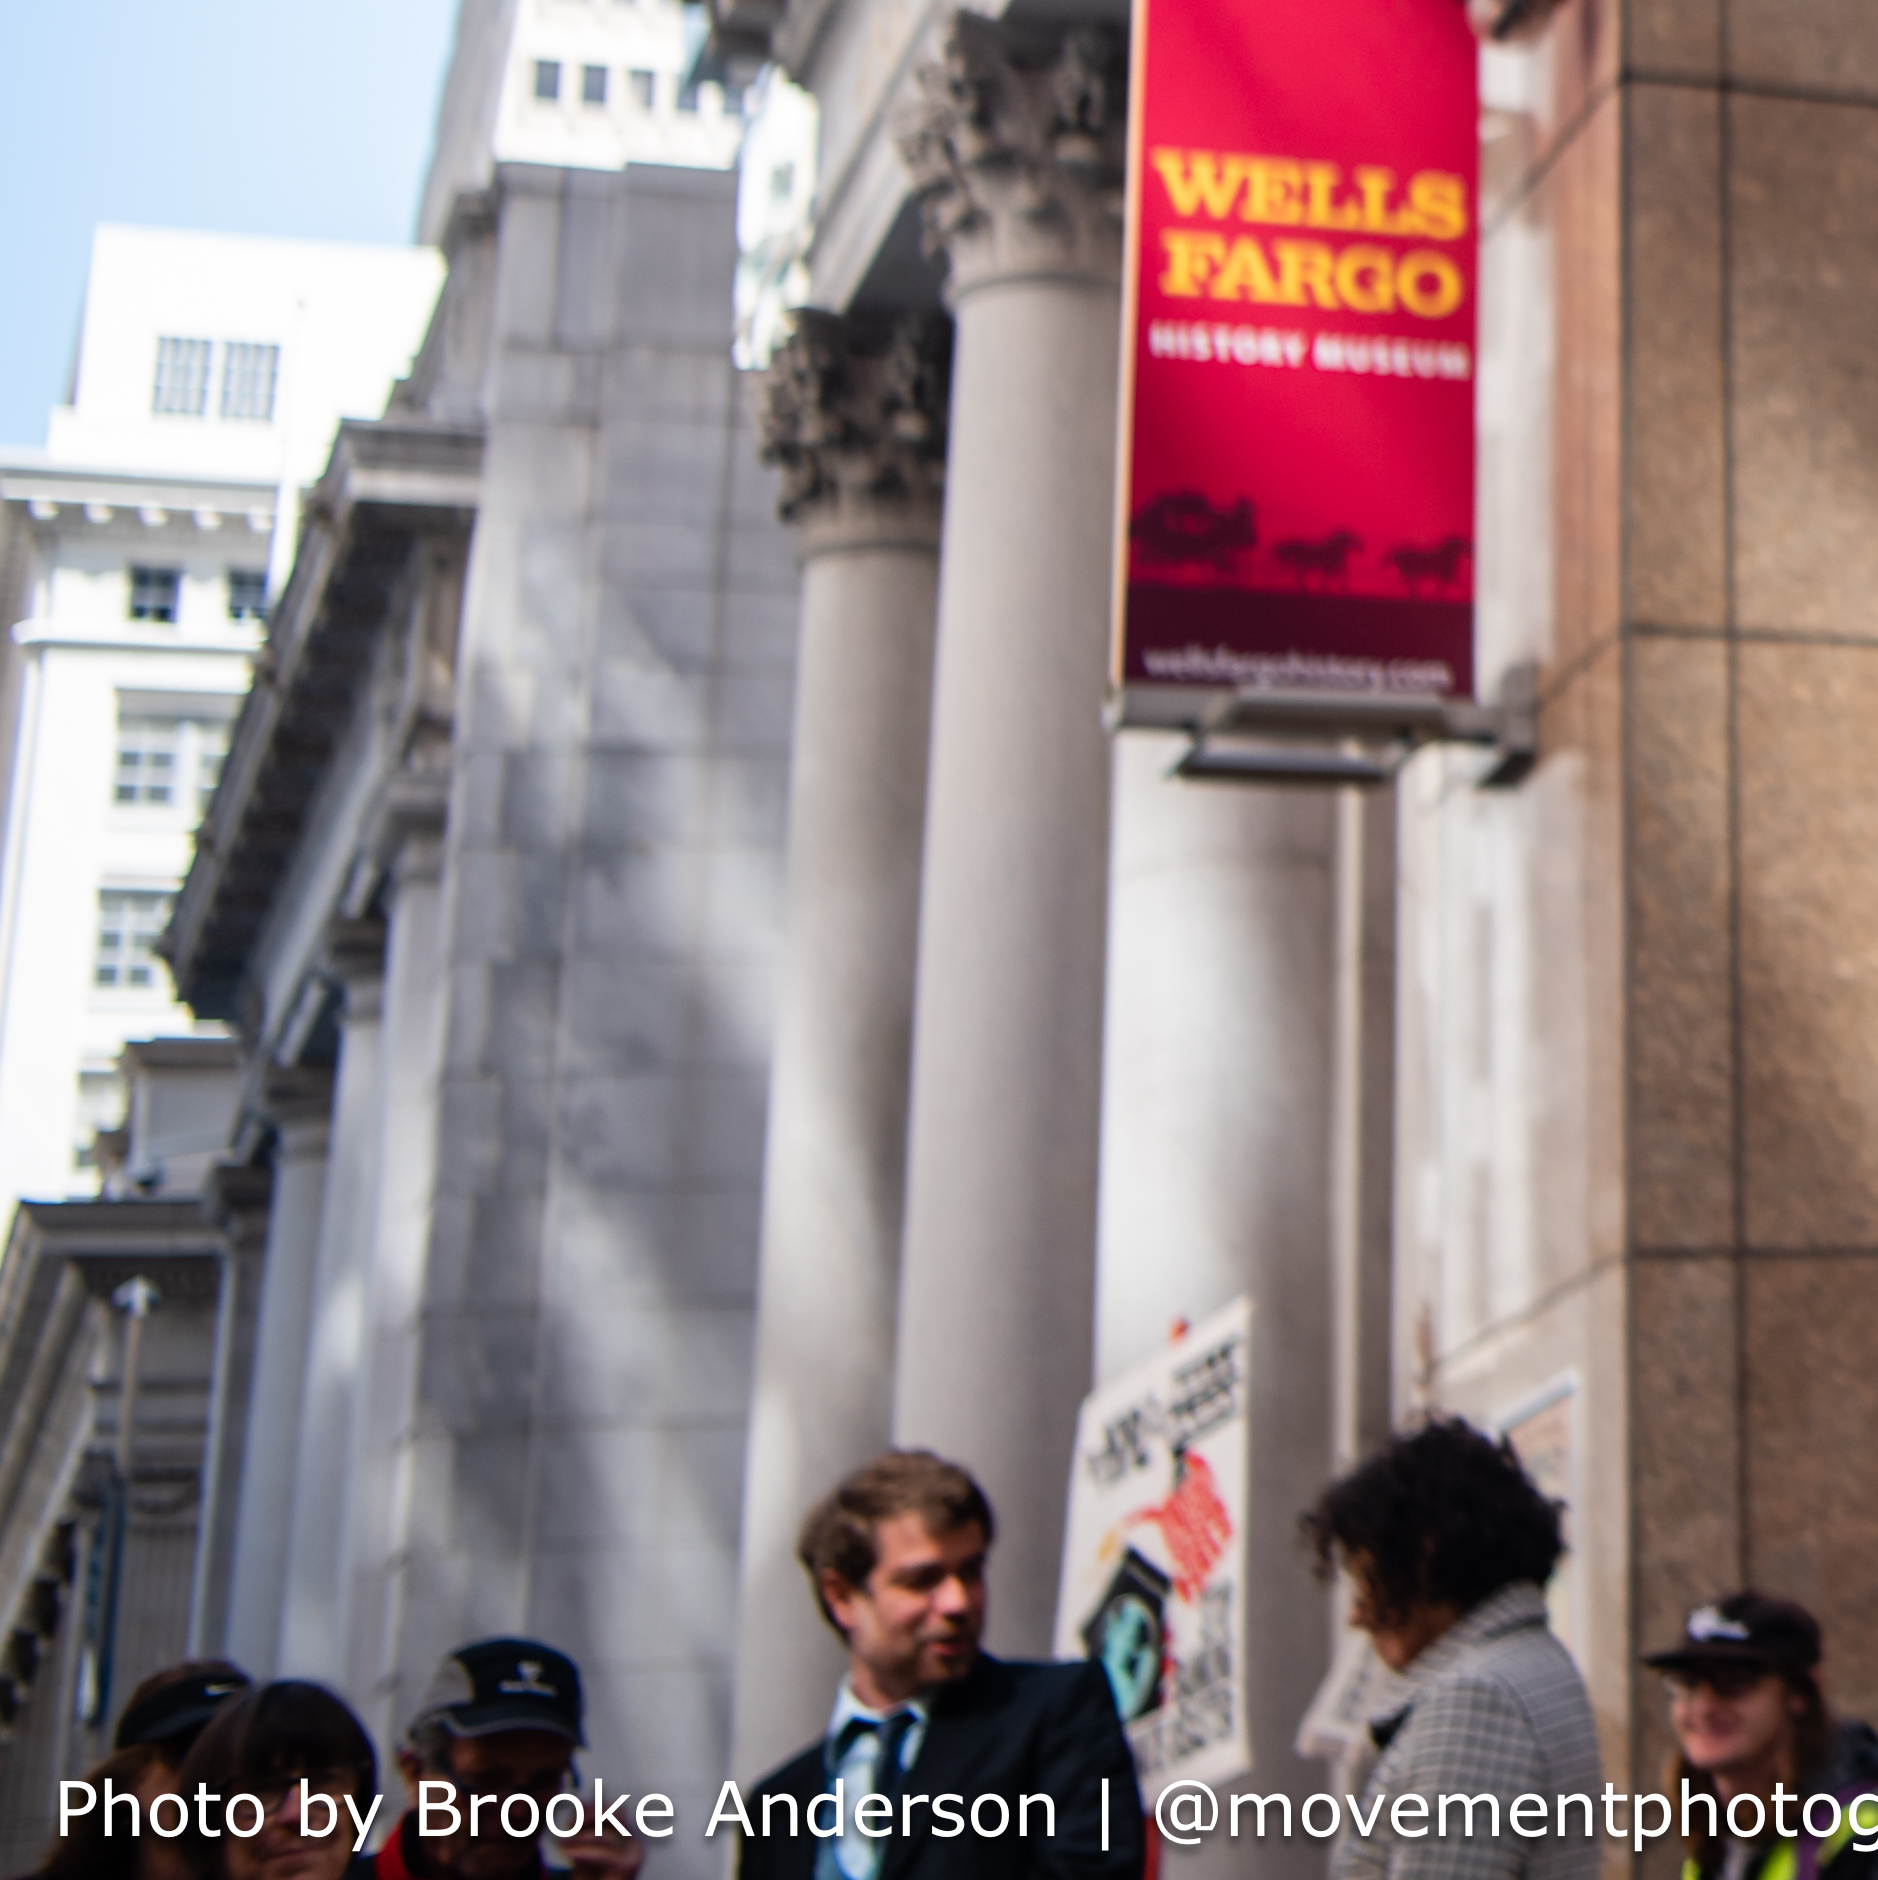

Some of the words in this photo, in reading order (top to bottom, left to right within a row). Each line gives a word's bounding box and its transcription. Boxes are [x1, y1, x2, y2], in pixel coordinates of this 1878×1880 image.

[1151, 145, 1467, 241] WELLS
[1159, 228, 1463, 319] FARGO
[1149, 319, 1306, 370] HISTORY
[1313, 331, 1471, 381] MUSEUM
